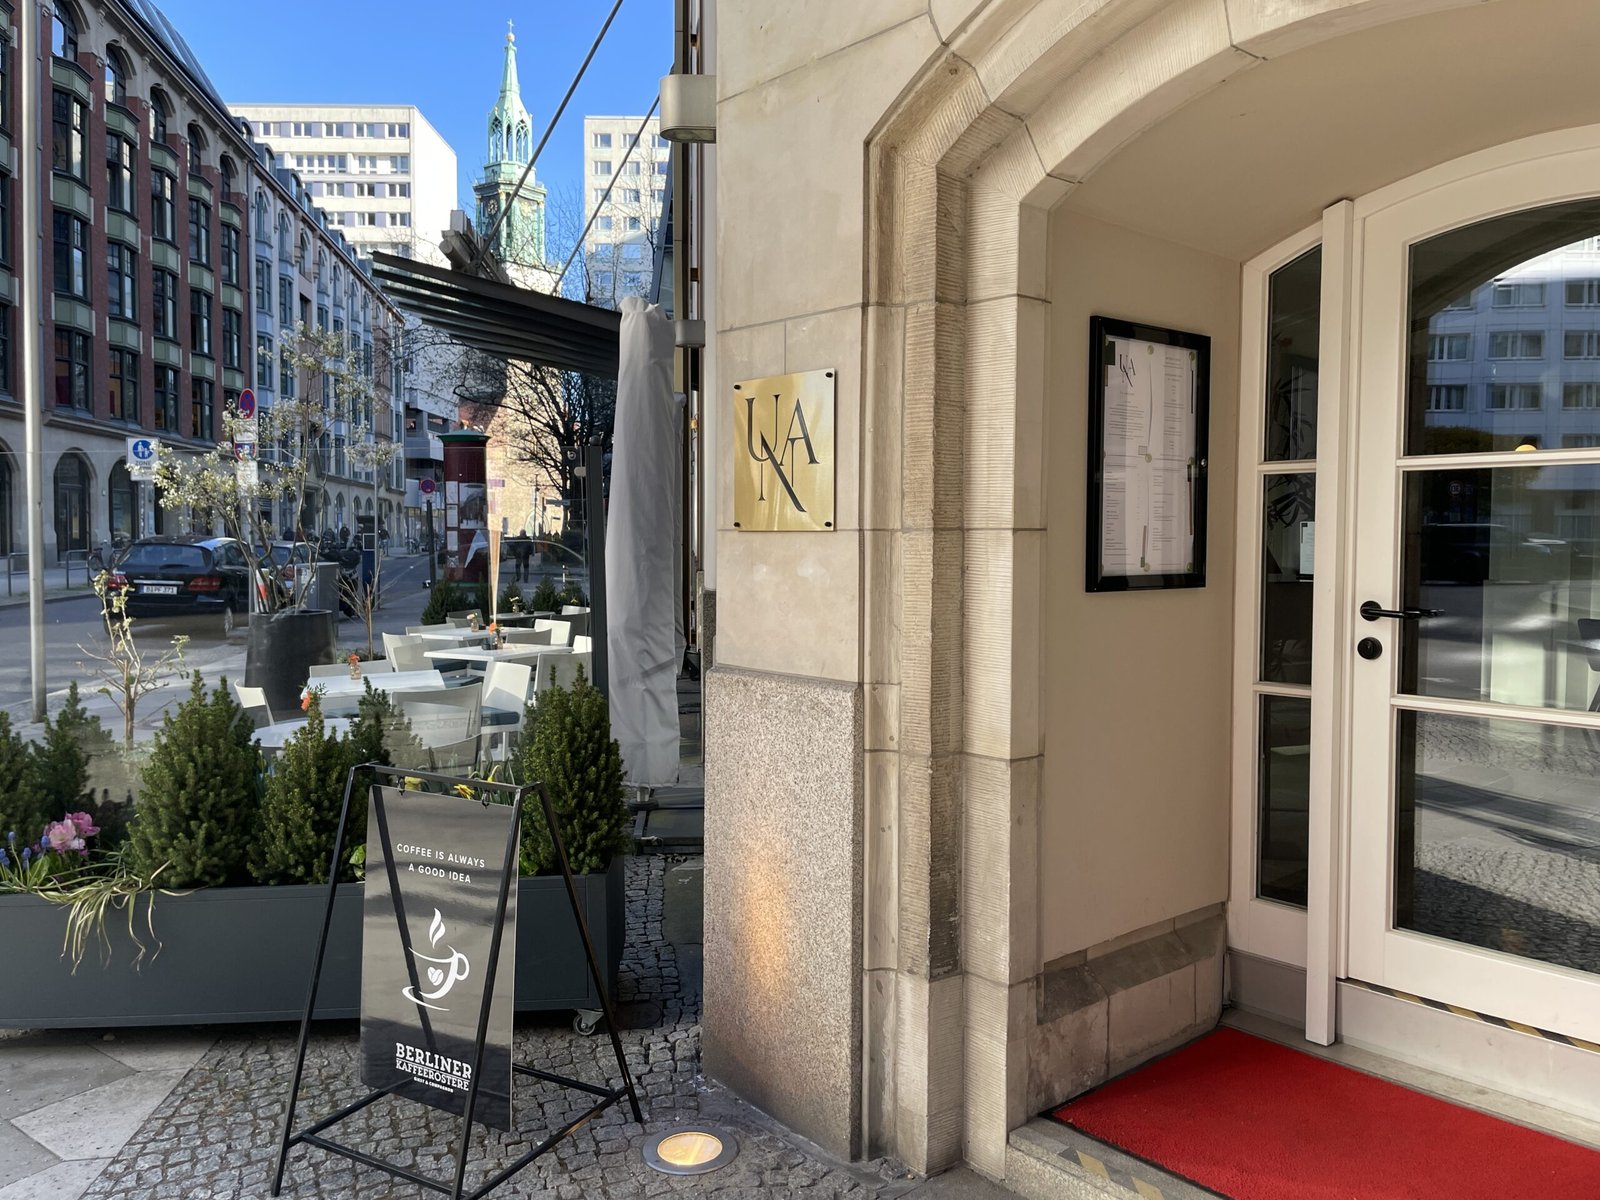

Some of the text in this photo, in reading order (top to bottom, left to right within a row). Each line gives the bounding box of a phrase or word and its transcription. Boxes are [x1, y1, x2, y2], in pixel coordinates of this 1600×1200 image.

[396, 843, 485, 868] COFFEE IS ALWAYS
[408, 863, 471, 883] A GOOD IDEA
[395, 1042, 472, 1079] BERLINER
